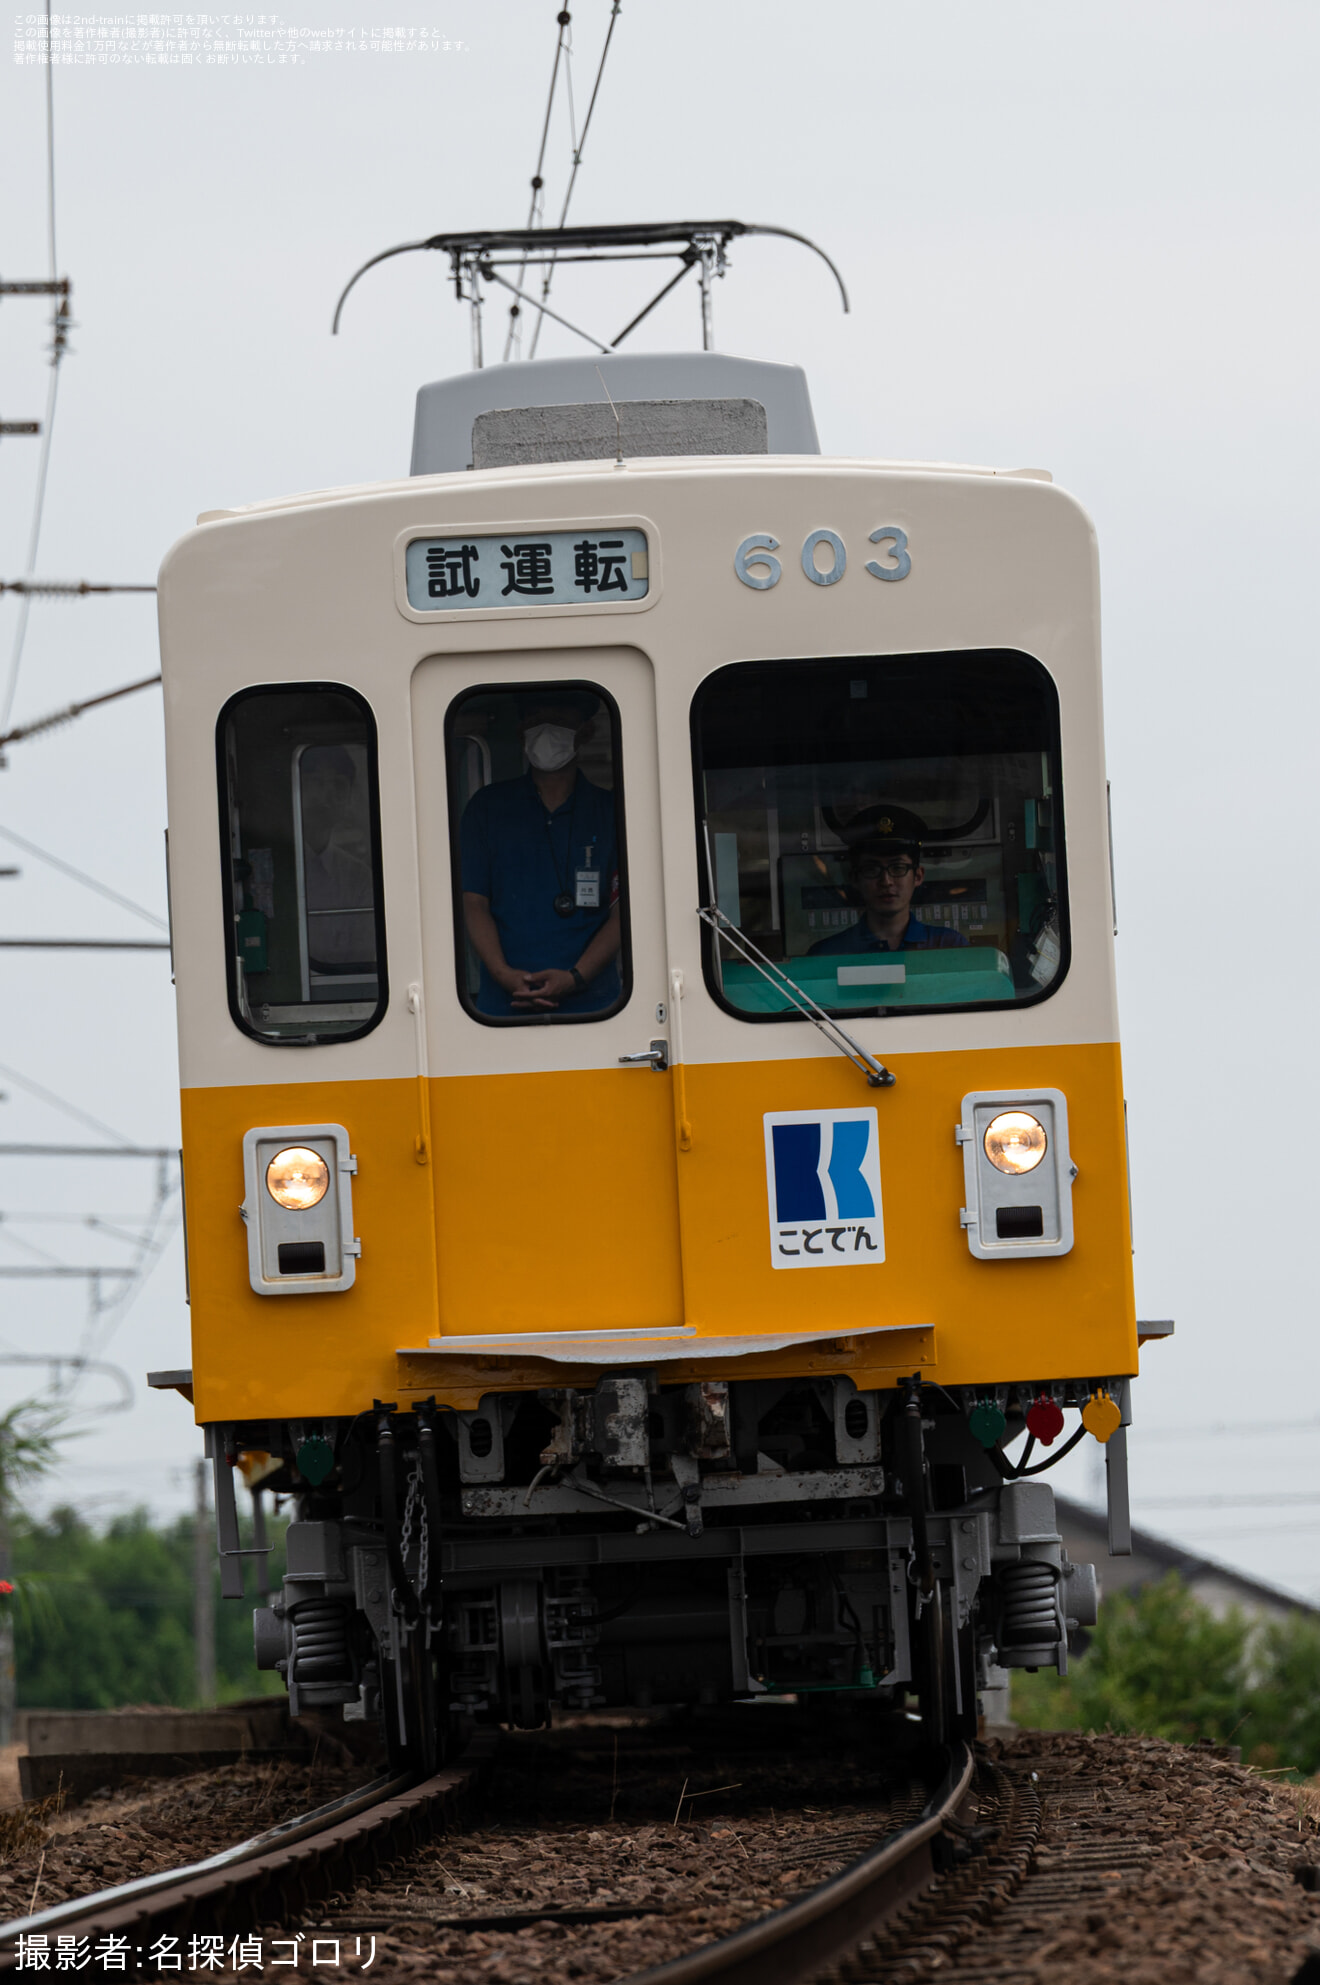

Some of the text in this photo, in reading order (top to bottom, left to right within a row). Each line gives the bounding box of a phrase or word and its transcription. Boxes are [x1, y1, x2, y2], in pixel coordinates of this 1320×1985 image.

[426, 540, 628, 598] 試運転
[735, 526, 911, 590] 603
[779, 1226, 878, 1255] ことでん
